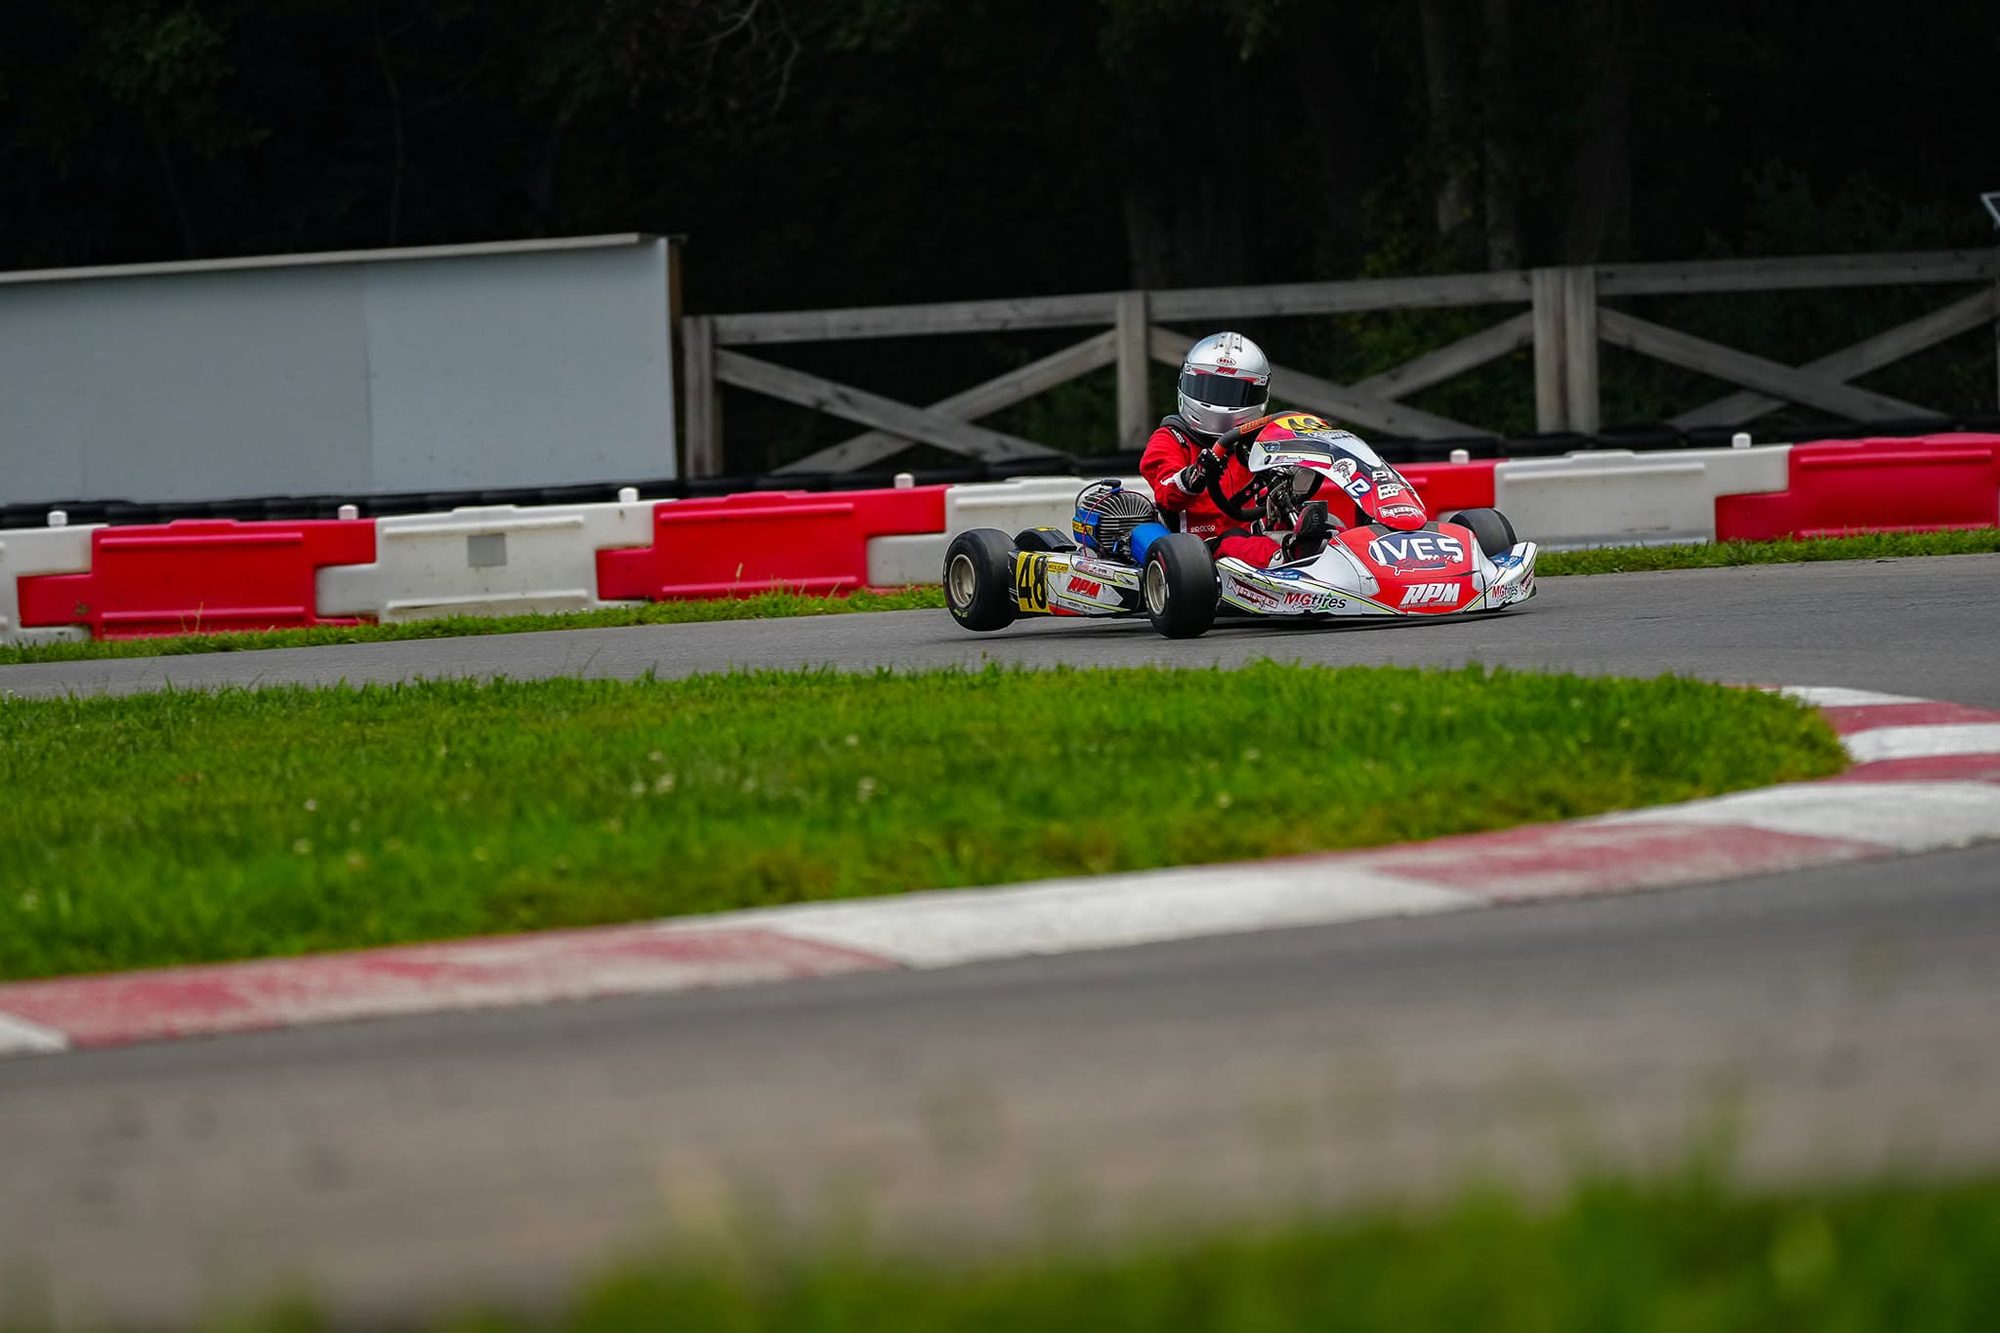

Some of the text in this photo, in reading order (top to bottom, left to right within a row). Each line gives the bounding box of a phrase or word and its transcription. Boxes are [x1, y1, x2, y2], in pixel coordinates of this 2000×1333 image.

[1369, 537, 1464, 566] IVES
[1066, 576, 1101, 600] RPM
[1400, 583, 1460, 606] RPM
